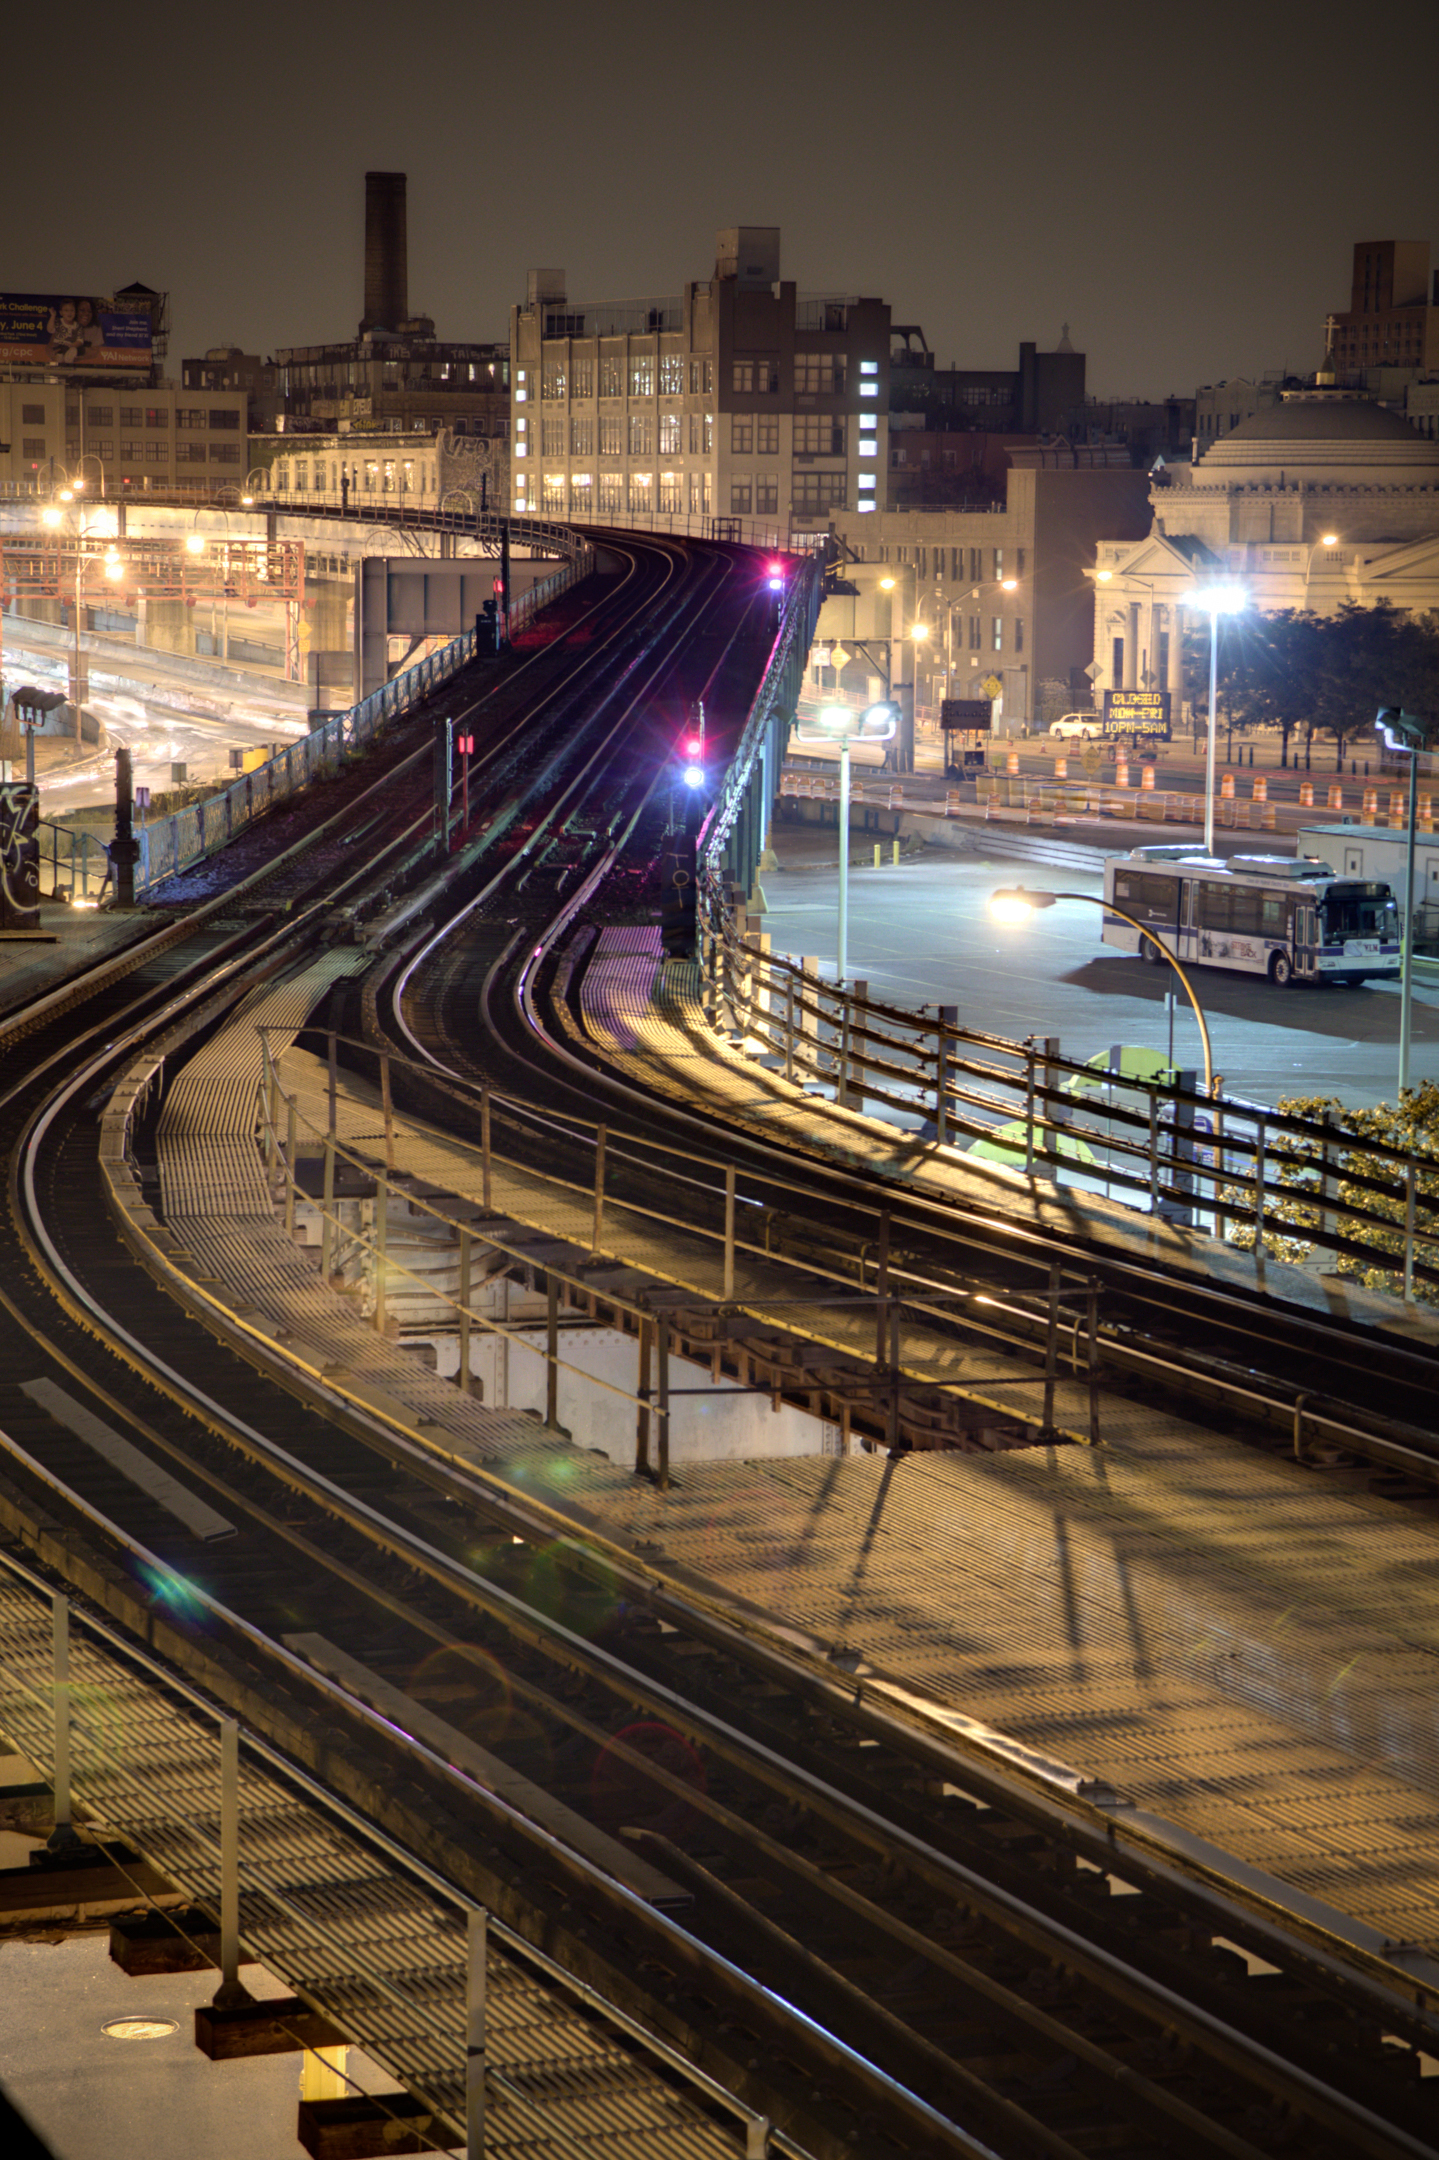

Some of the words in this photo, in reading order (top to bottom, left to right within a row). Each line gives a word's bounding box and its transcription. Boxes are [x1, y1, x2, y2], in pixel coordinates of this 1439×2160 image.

[9, 302, 48, 314] Challenge
[11, 319, 35, 330] June
[36, 321, 43, 331] 4
[101, 351, 118, 361] YAI
[118, 353, 150, 362] Network
[1112, 693, 1162, 705] CLOSED
[1109, 707, 1164, 720] MON-FRI
[1104, 721, 1168, 734] 10PM-5AM
[1240, 949, 1257, 959] BACK
